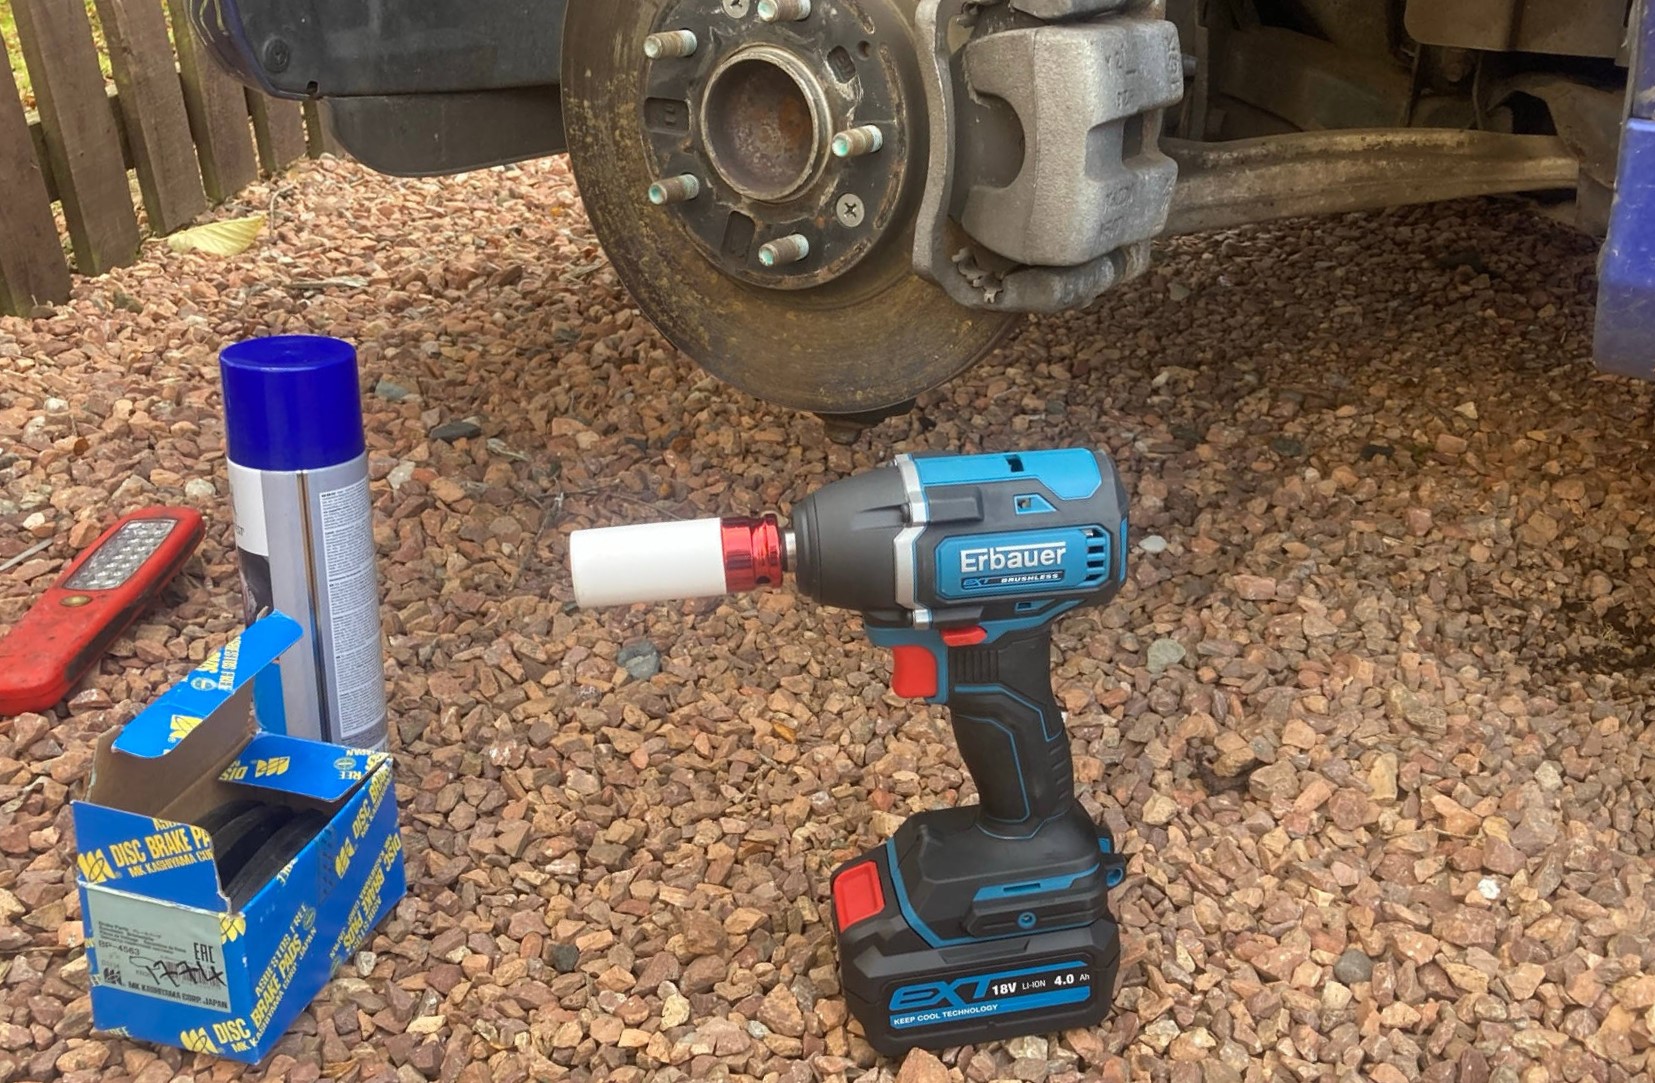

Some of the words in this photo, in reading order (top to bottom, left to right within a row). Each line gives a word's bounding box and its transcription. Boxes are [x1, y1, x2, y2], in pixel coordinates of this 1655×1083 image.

[960, 541, 1067, 573] Erbauer
[1000, 573, 1060, 584] BRUSHLESS
[109, 839, 146, 868] DISC
[144, 827, 192, 859] BRAKE
[193, 942, 216, 964] EAC
[254, 933, 291, 998] ASBESTOS
[289, 902, 308, 934] FREE
[212, 1018, 251, 1044] DISC
[250, 972, 282, 1019] BRAKE
[278, 932, 302, 979] PADS
[992, 982, 1017, 996] 18V
[1021, 979, 1047, 991] LI-ION
[1053, 974, 1075, 986] 4.0
[1079, 973, 1090, 982] Ah
[893, 1015, 917, 1026] KEEP
[917, 1012, 941, 1022] COOL
[942, 1003, 999, 1018] TECHNOLOGY
